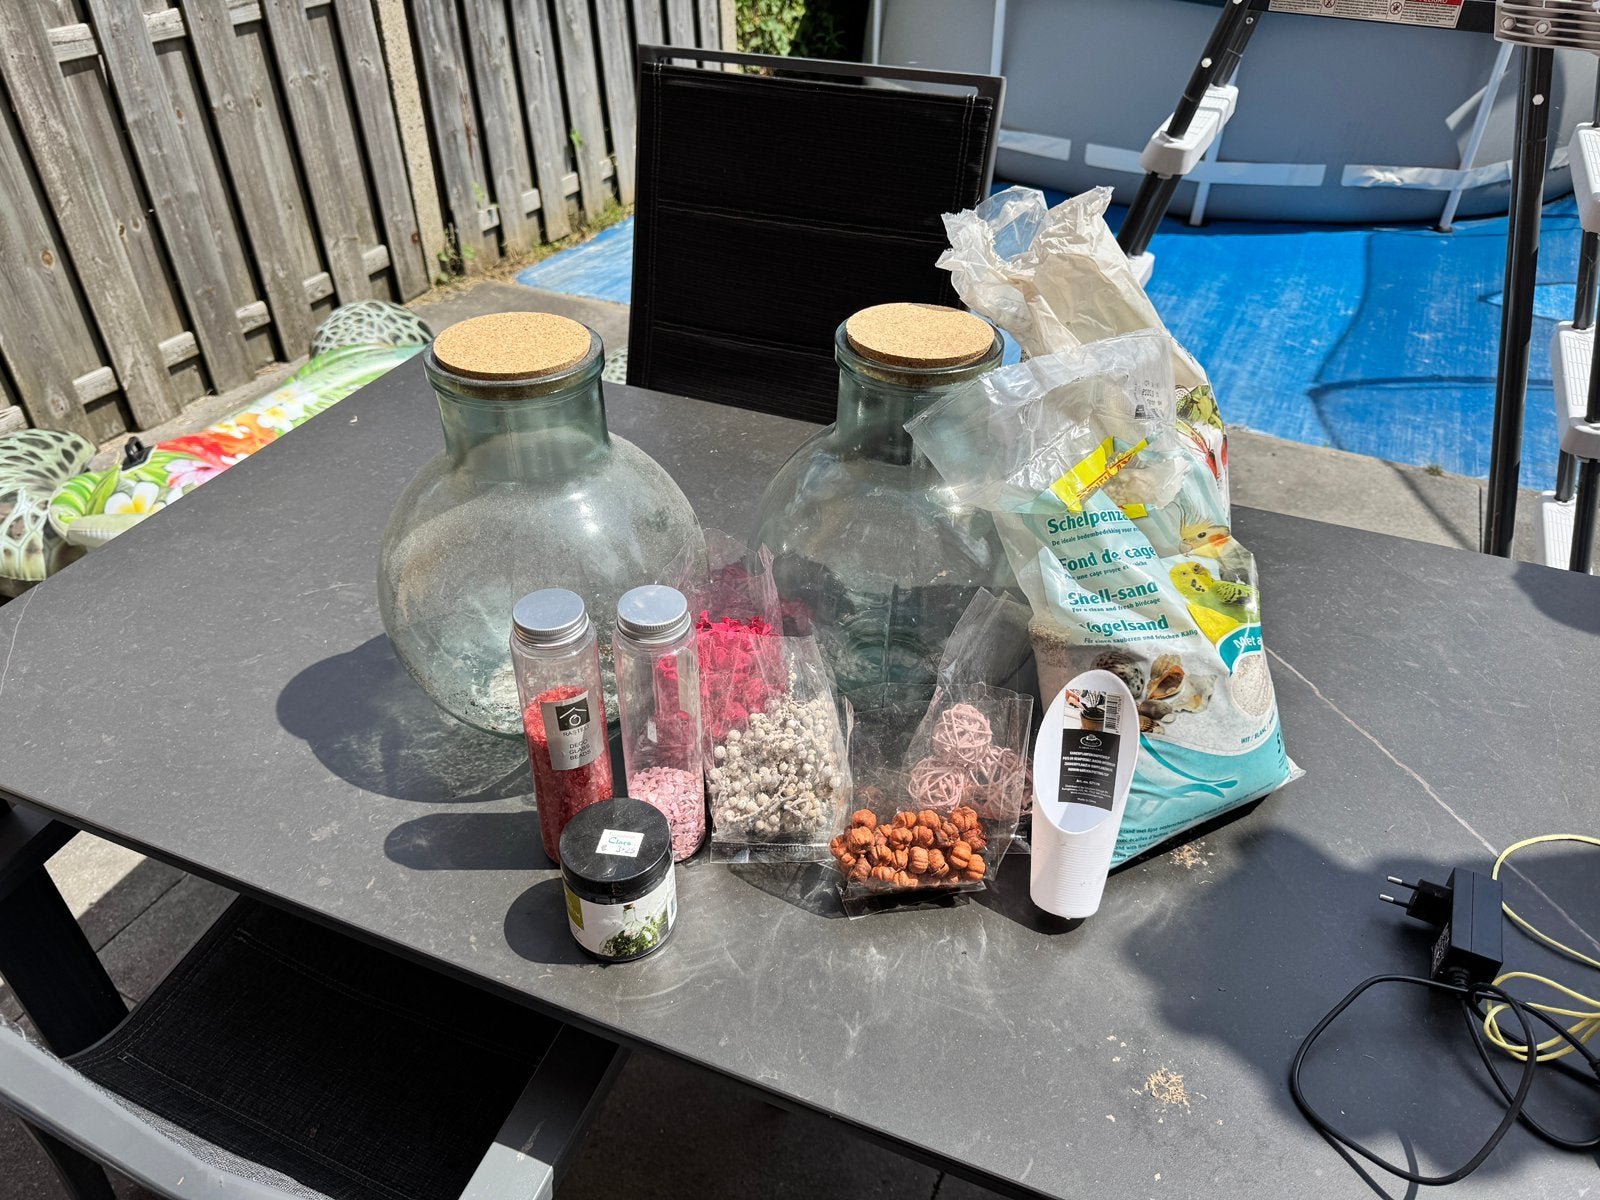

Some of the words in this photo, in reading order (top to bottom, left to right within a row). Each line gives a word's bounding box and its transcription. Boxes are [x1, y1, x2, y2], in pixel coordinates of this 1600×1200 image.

[1101, 549, 1121, 563] de
[1124, 546, 1156, 560] cage
[1090, 569, 1103, 577] cage
[1067, 581, 1159, 605] Shell-sand
[1135, 598, 1161, 608] birdcage
[1181, 629, 1199, 637] Käfig
[1233, 635, 1256, 649] Met
[568, 743, 591, 755] GLASS
[569, 749, 592, 761] BEADS
